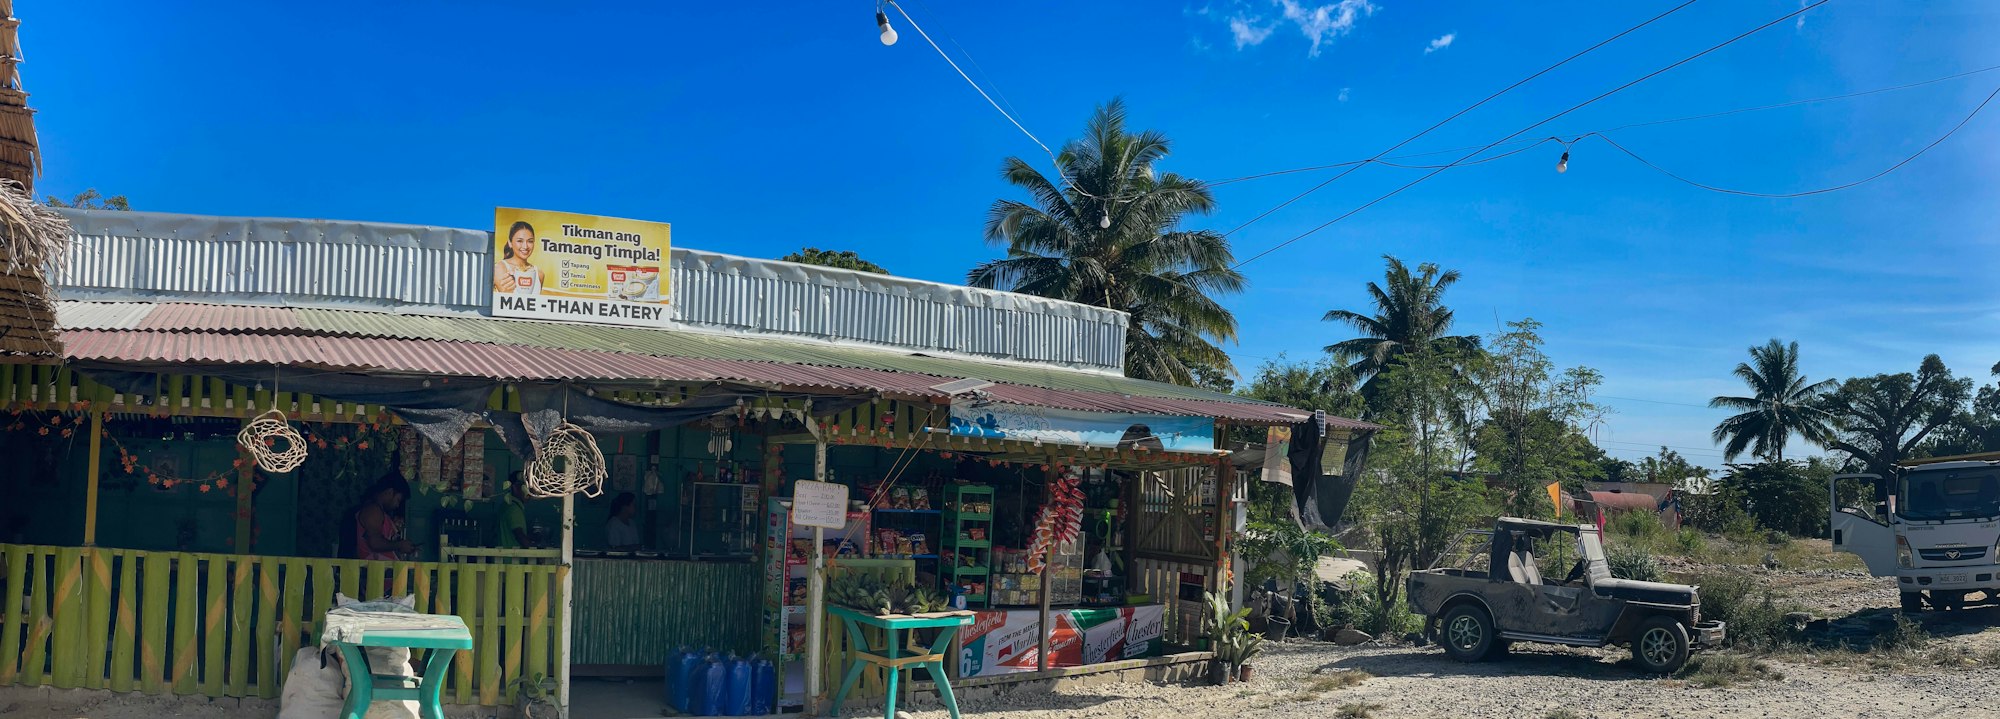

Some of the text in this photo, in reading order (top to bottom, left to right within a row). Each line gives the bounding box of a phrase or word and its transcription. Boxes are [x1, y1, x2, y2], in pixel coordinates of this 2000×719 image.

[562, 224, 641, 246] Tikman ang
[541, 239, 660, 263] Tamang Timpla!
[500, 296, 536, 311] MAE
[599, 303, 662, 320] EATERY
[962, 648, 973, 677] 6
